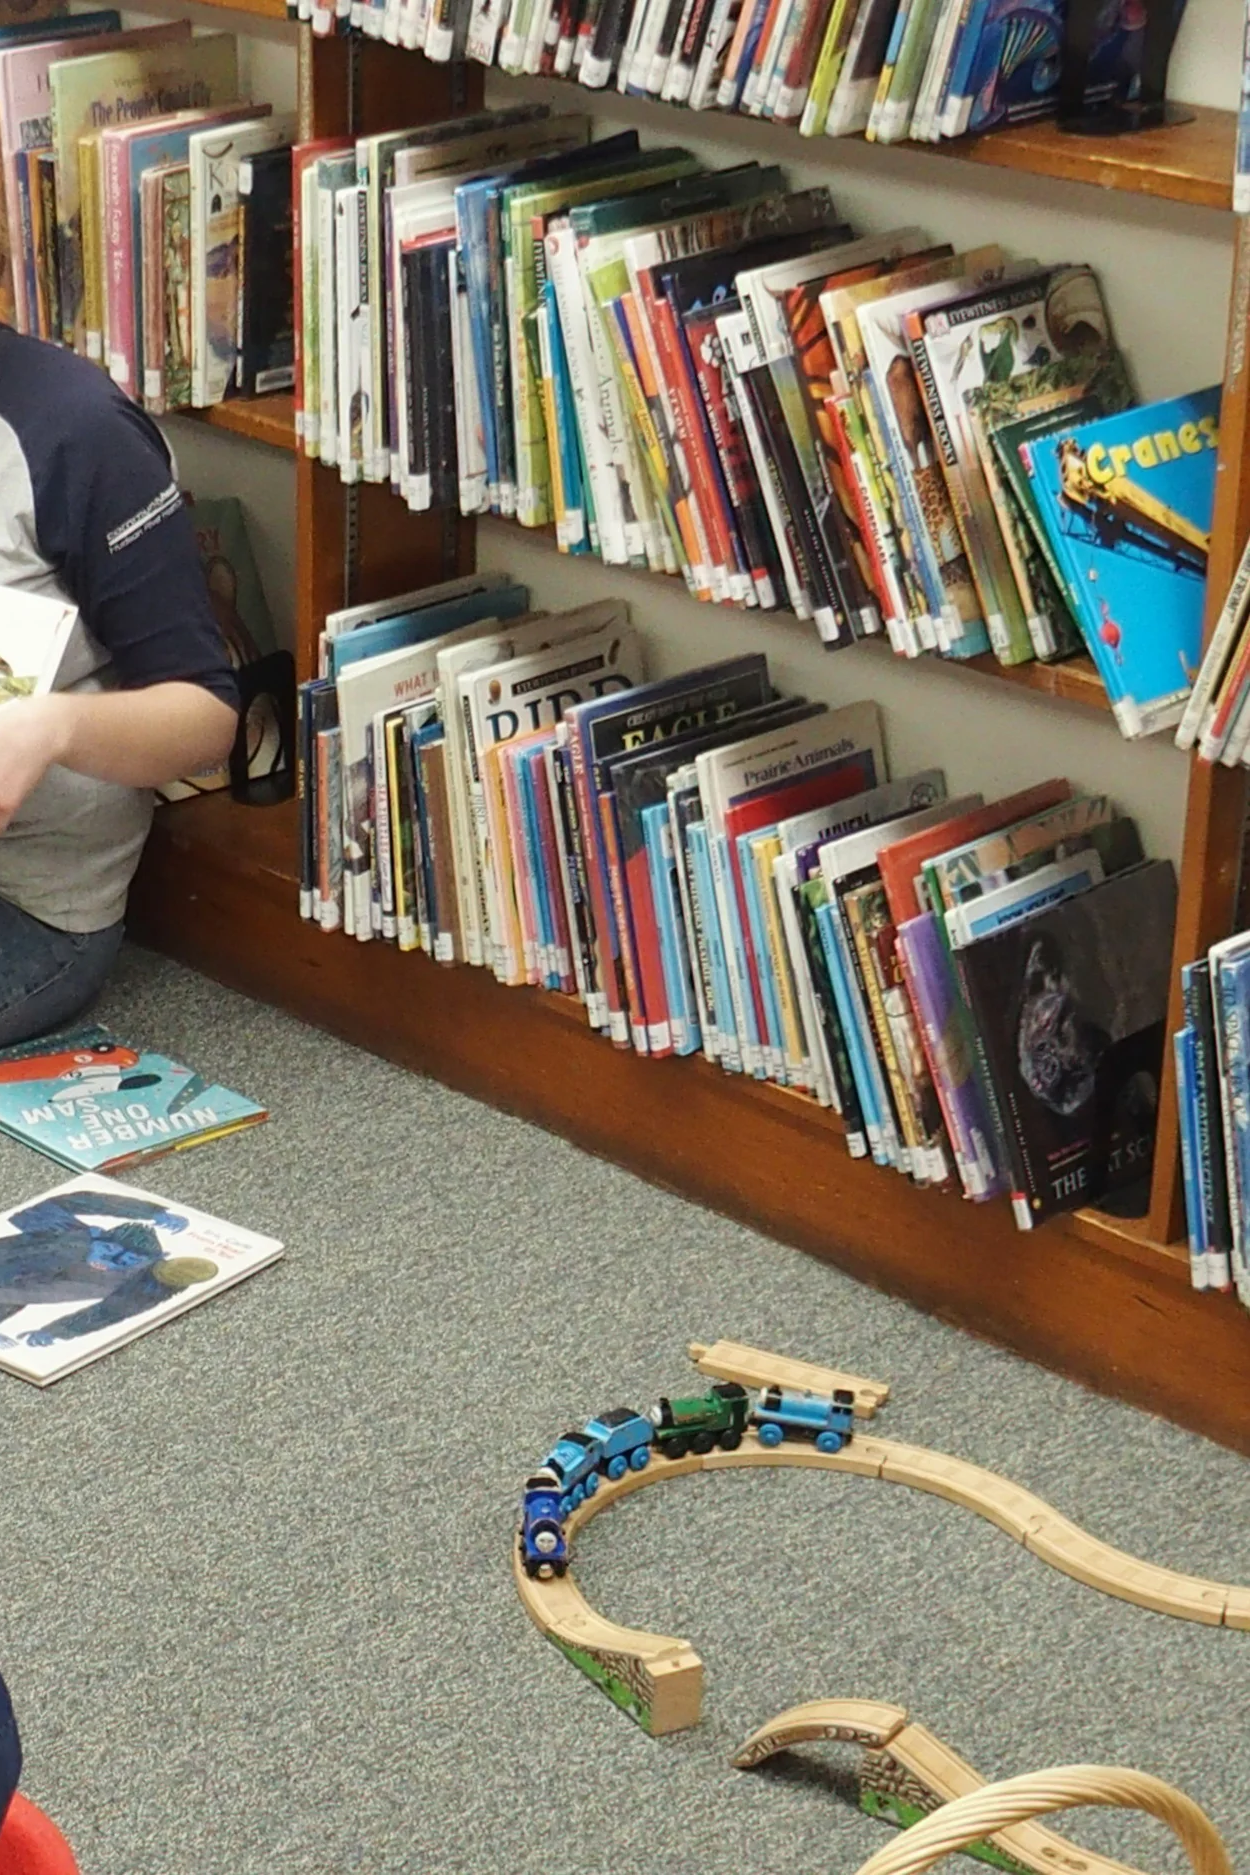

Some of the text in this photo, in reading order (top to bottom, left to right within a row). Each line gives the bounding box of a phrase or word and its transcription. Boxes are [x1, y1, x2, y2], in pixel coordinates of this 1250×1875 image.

[91, 101, 111, 127] The
[597, 375, 623, 454] Animals
[706, 403, 723, 448] ANIMAL
[912, 339, 957, 465] EYEWITNESS BOOKS
[1086, 416, 1219, 484] Cranes
[861, 487, 887, 565] CATERPILLARS
[394, 671, 427, 697] WHAT
[567, 720, 584, 775] EAGLE
[743, 759, 791, 787] Prairie
[793, 738, 856, 770] Animals
[696, 932, 712, 984] PRAIRIE
[21, 1097, 100, 1125] SAM
[66, 1107, 219, 1151] NUMBER
[81, 1103, 150, 1132] ONE
[1193, 1039, 1215, 1224] SPACE STATION SCIENCE
[1051, 1166, 1087, 1200] THE
